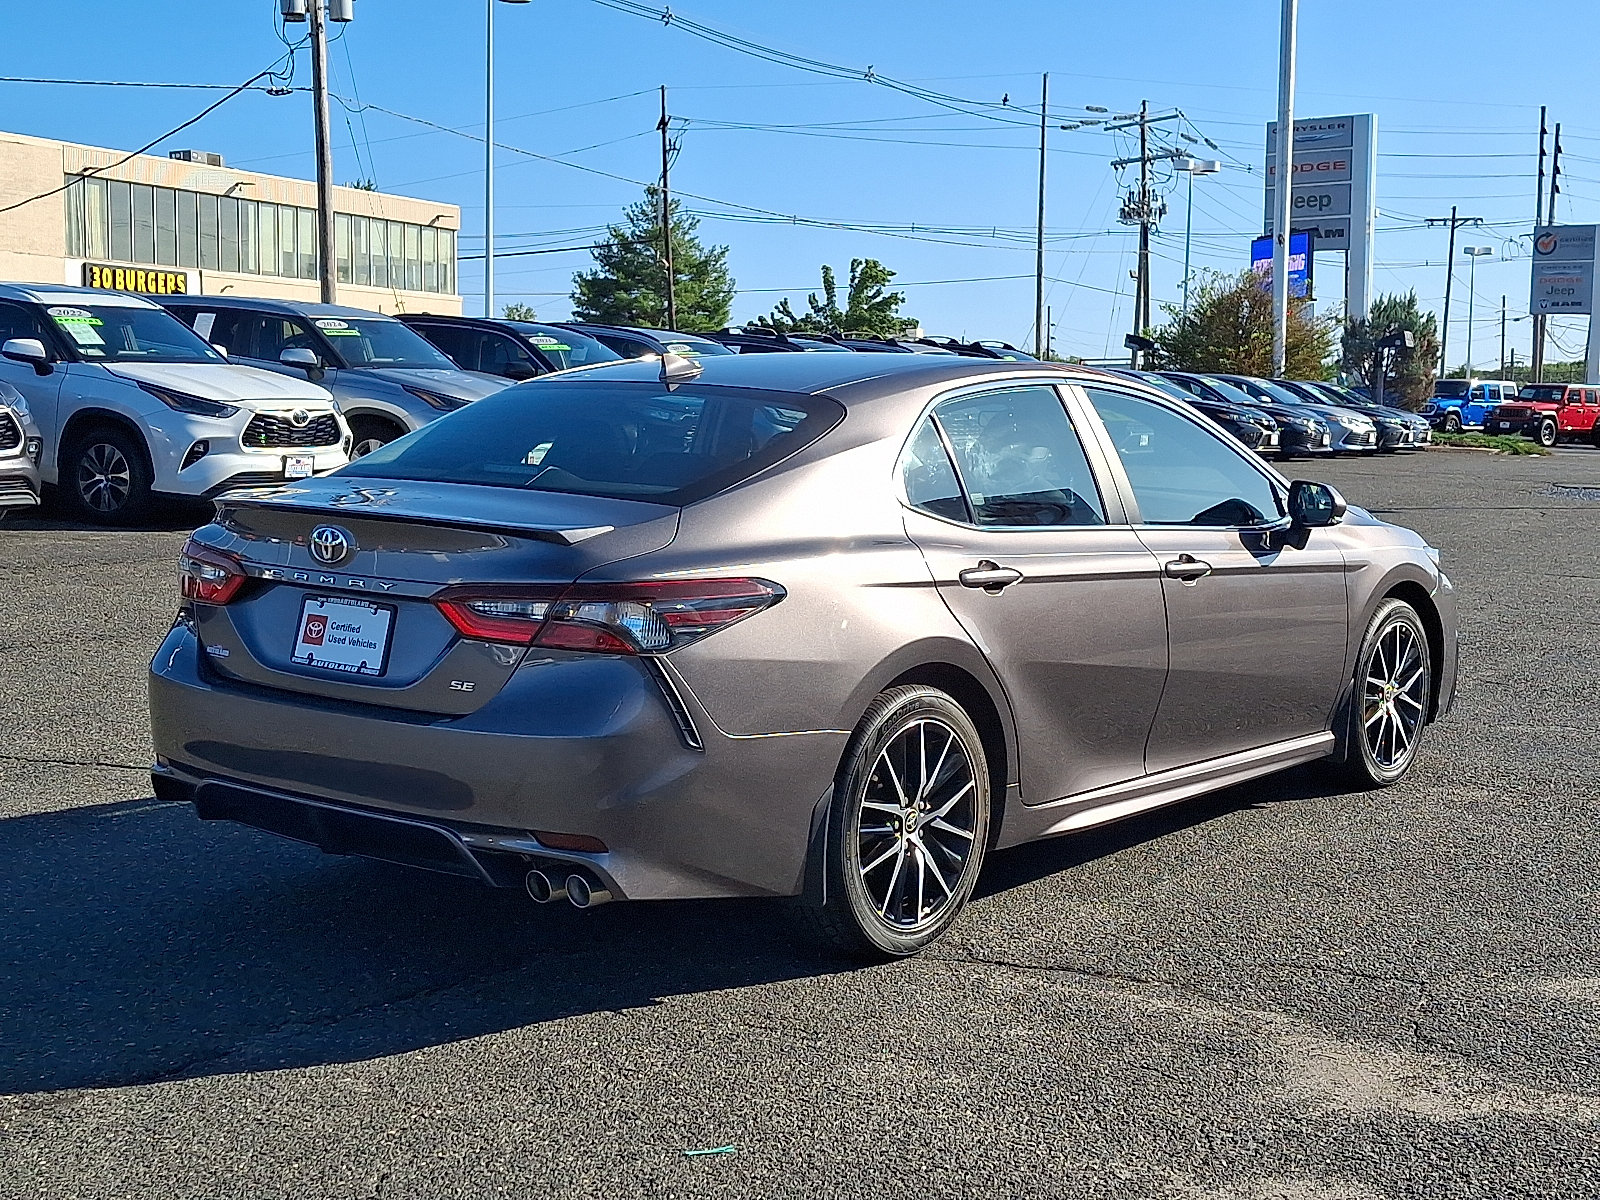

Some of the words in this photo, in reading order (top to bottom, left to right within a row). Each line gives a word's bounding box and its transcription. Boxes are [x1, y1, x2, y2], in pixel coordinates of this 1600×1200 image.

[1272, 123, 1346, 134] CRYSLER
[1293, 194, 1332, 211] eep
[91, 266, 113, 289] 30
[115, 269, 186, 294] BURGERS
[1545, 285, 1575, 297] Jeep
[269, 569, 398, 591] CAMRY
[330, 621, 362, 634] Certified
[328, 634, 346, 645] Used
[348, 636, 377, 650] Vehicles
[310, 659, 359, 672] AUTOLAND
[449, 680, 476, 692] SE
